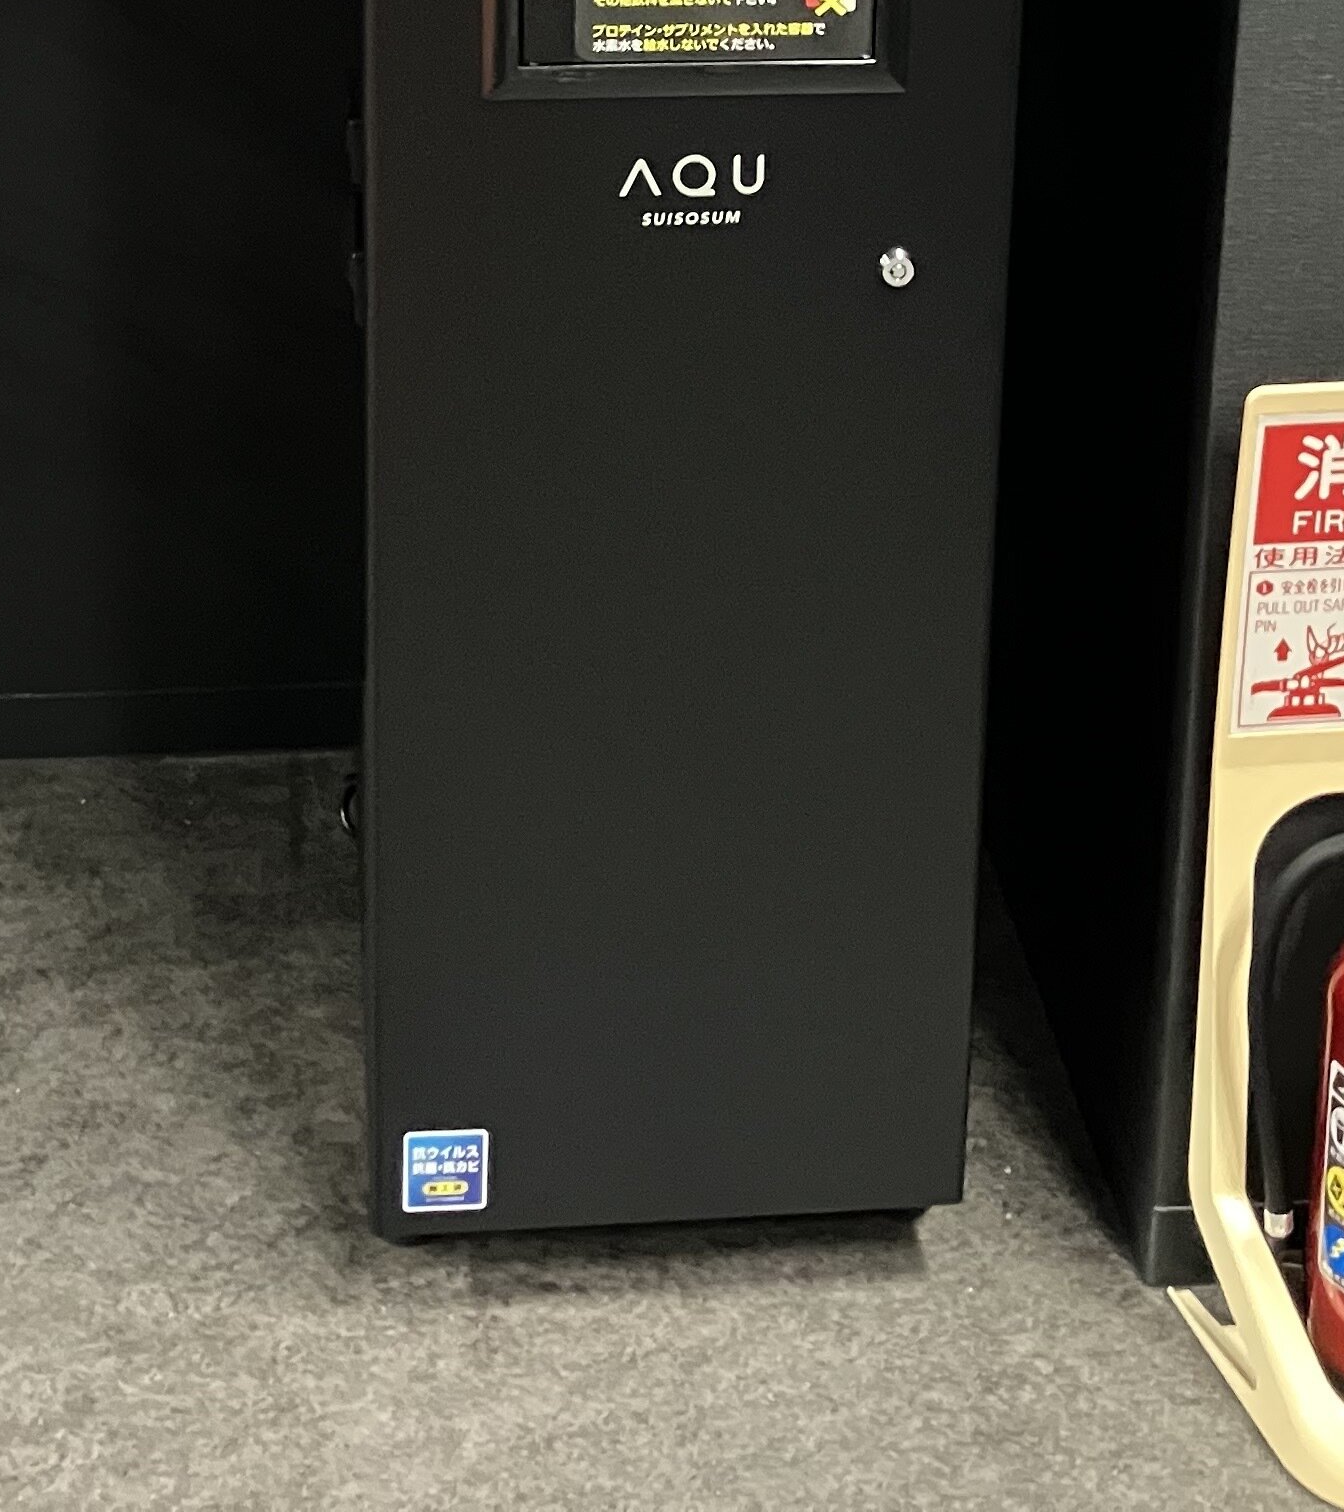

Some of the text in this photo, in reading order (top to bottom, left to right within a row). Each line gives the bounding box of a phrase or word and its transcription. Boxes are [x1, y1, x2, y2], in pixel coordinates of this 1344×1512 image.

[641, 210, 741, 227] SUISOSUM
[1257, 601, 1289, 615] PULL
[1294, 599, 1319, 614] OUT
[1255, 619, 1277, 633] PIN
